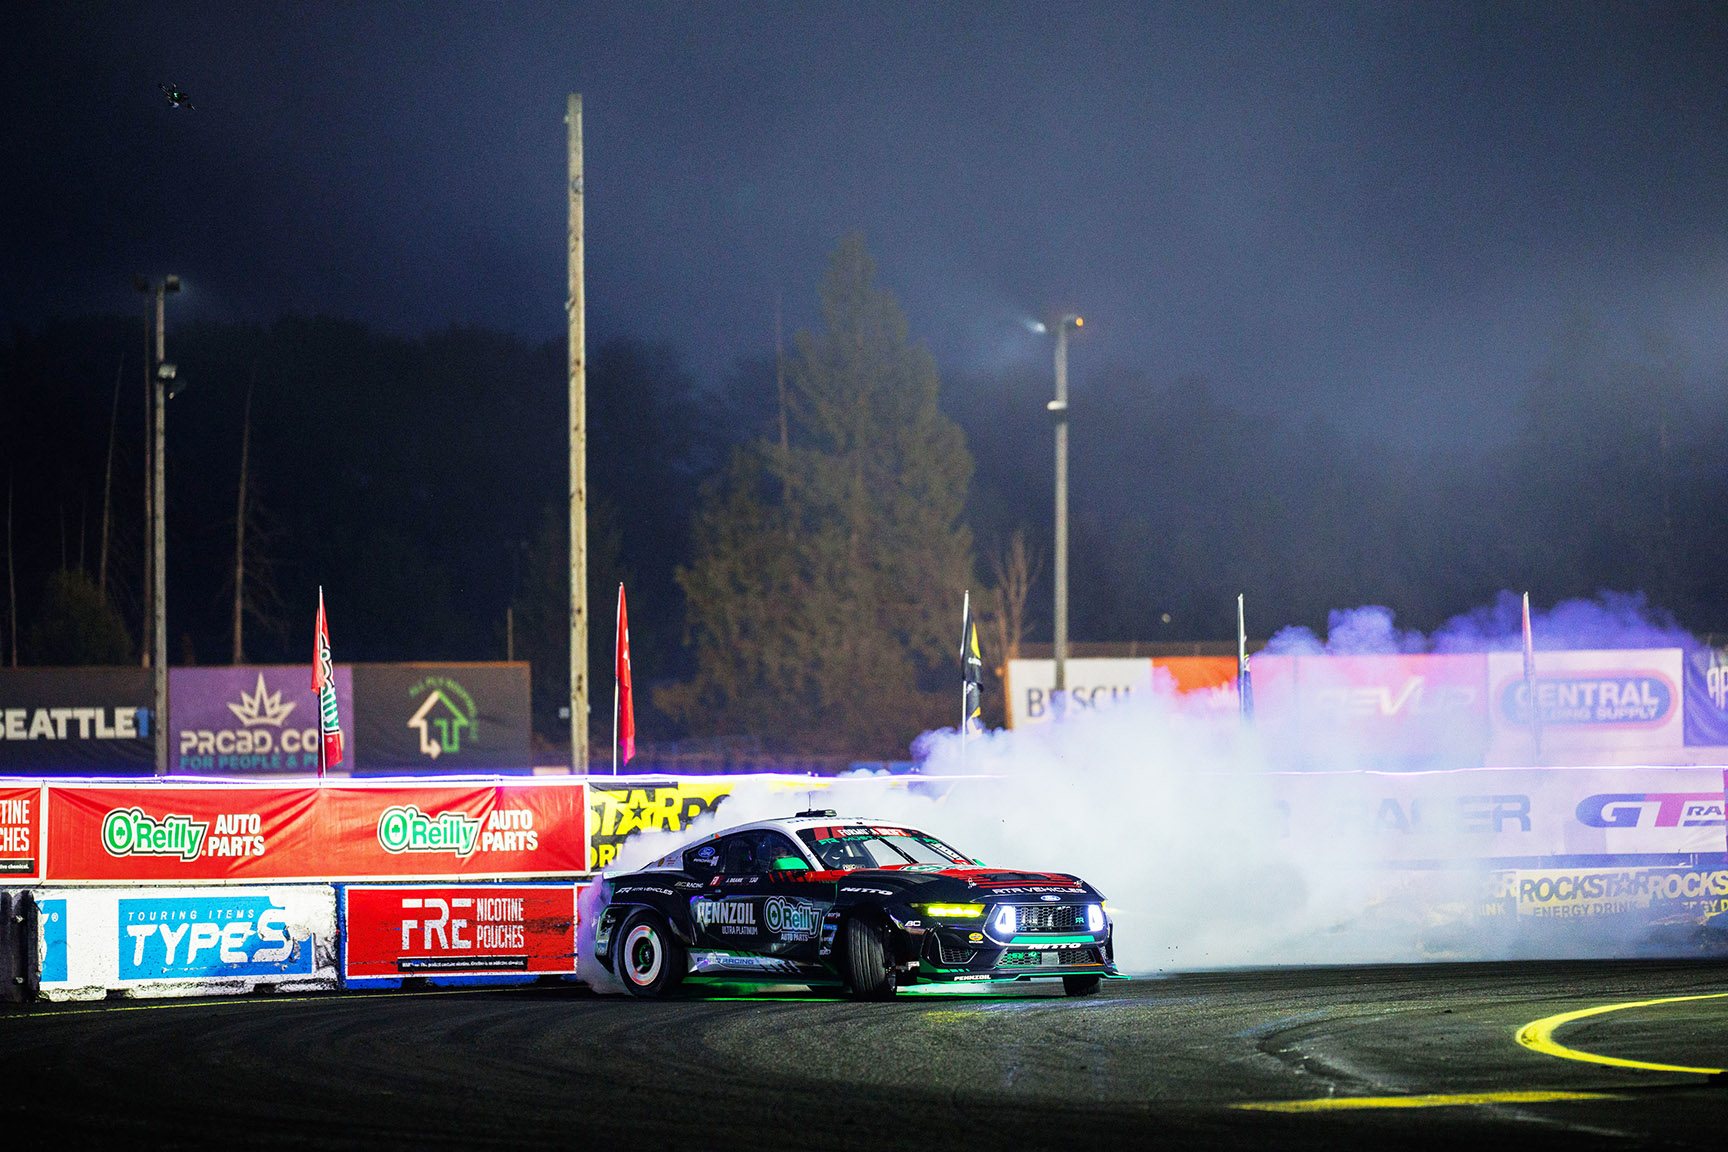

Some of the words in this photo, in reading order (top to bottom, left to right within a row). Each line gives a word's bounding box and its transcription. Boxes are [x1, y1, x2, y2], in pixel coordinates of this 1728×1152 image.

[1027, 687, 1130, 717] BSC
[1515, 680, 1658, 706] CENTRAL
[180, 755, 214, 769] FOR
[219, 754, 281, 769] PEOPLE
[214, 814, 260, 834] AUTO
[488, 810, 533, 830] AUTO
[107, 814, 201, 854] O'Reilly
[383, 812, 474, 850] O'Reilly
[482, 831, 538, 851] PARTS
[208, 836, 265, 857] PARTS
[643, 887, 673, 896] VEHICLES
[840, 887, 893, 896] NITTO
[1024, 886, 1087, 894] VEHICLES
[1519, 869, 1649, 902] ROCKSTAR
[128, 911, 197, 921] TOURING
[209, 909, 255, 919] ITEMS
[697, 902, 756, 924] PENNZOIL
[767, 899, 820, 935] O'Reilly
[1534, 903, 1589, 918] ENERGY
[1593, 901, 1637, 915] DRIN
[402, 898, 472, 950] FRE
[477, 898, 524, 921] NICOTINE
[722, 926, 736, 935] ULTRA
[735, 926, 758, 935] PLATINUM
[477, 925, 524, 949] POUCHES
[781, 933, 793, 941] AUTO
[794, 934, 808, 942] PARTS
